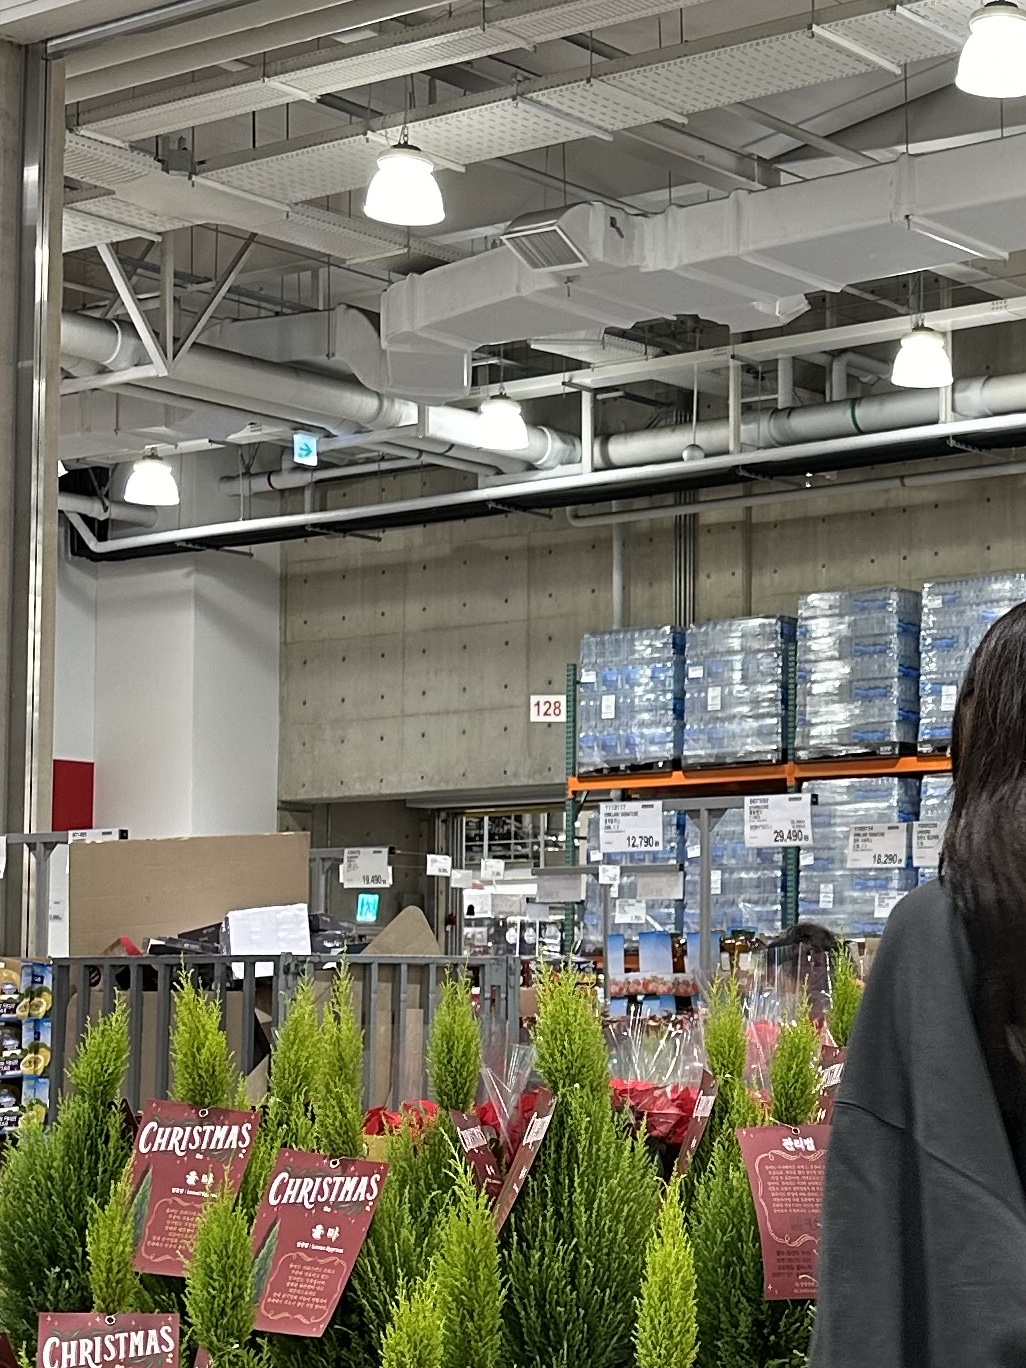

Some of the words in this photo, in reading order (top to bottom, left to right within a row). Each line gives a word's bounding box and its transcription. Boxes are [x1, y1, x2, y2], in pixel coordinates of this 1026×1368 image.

[533, 700, 562, 717] 128
[138, 1121, 252, 1157] CHRISTMAS
[268, 1171, 381, 1210] CHRISTMAS
